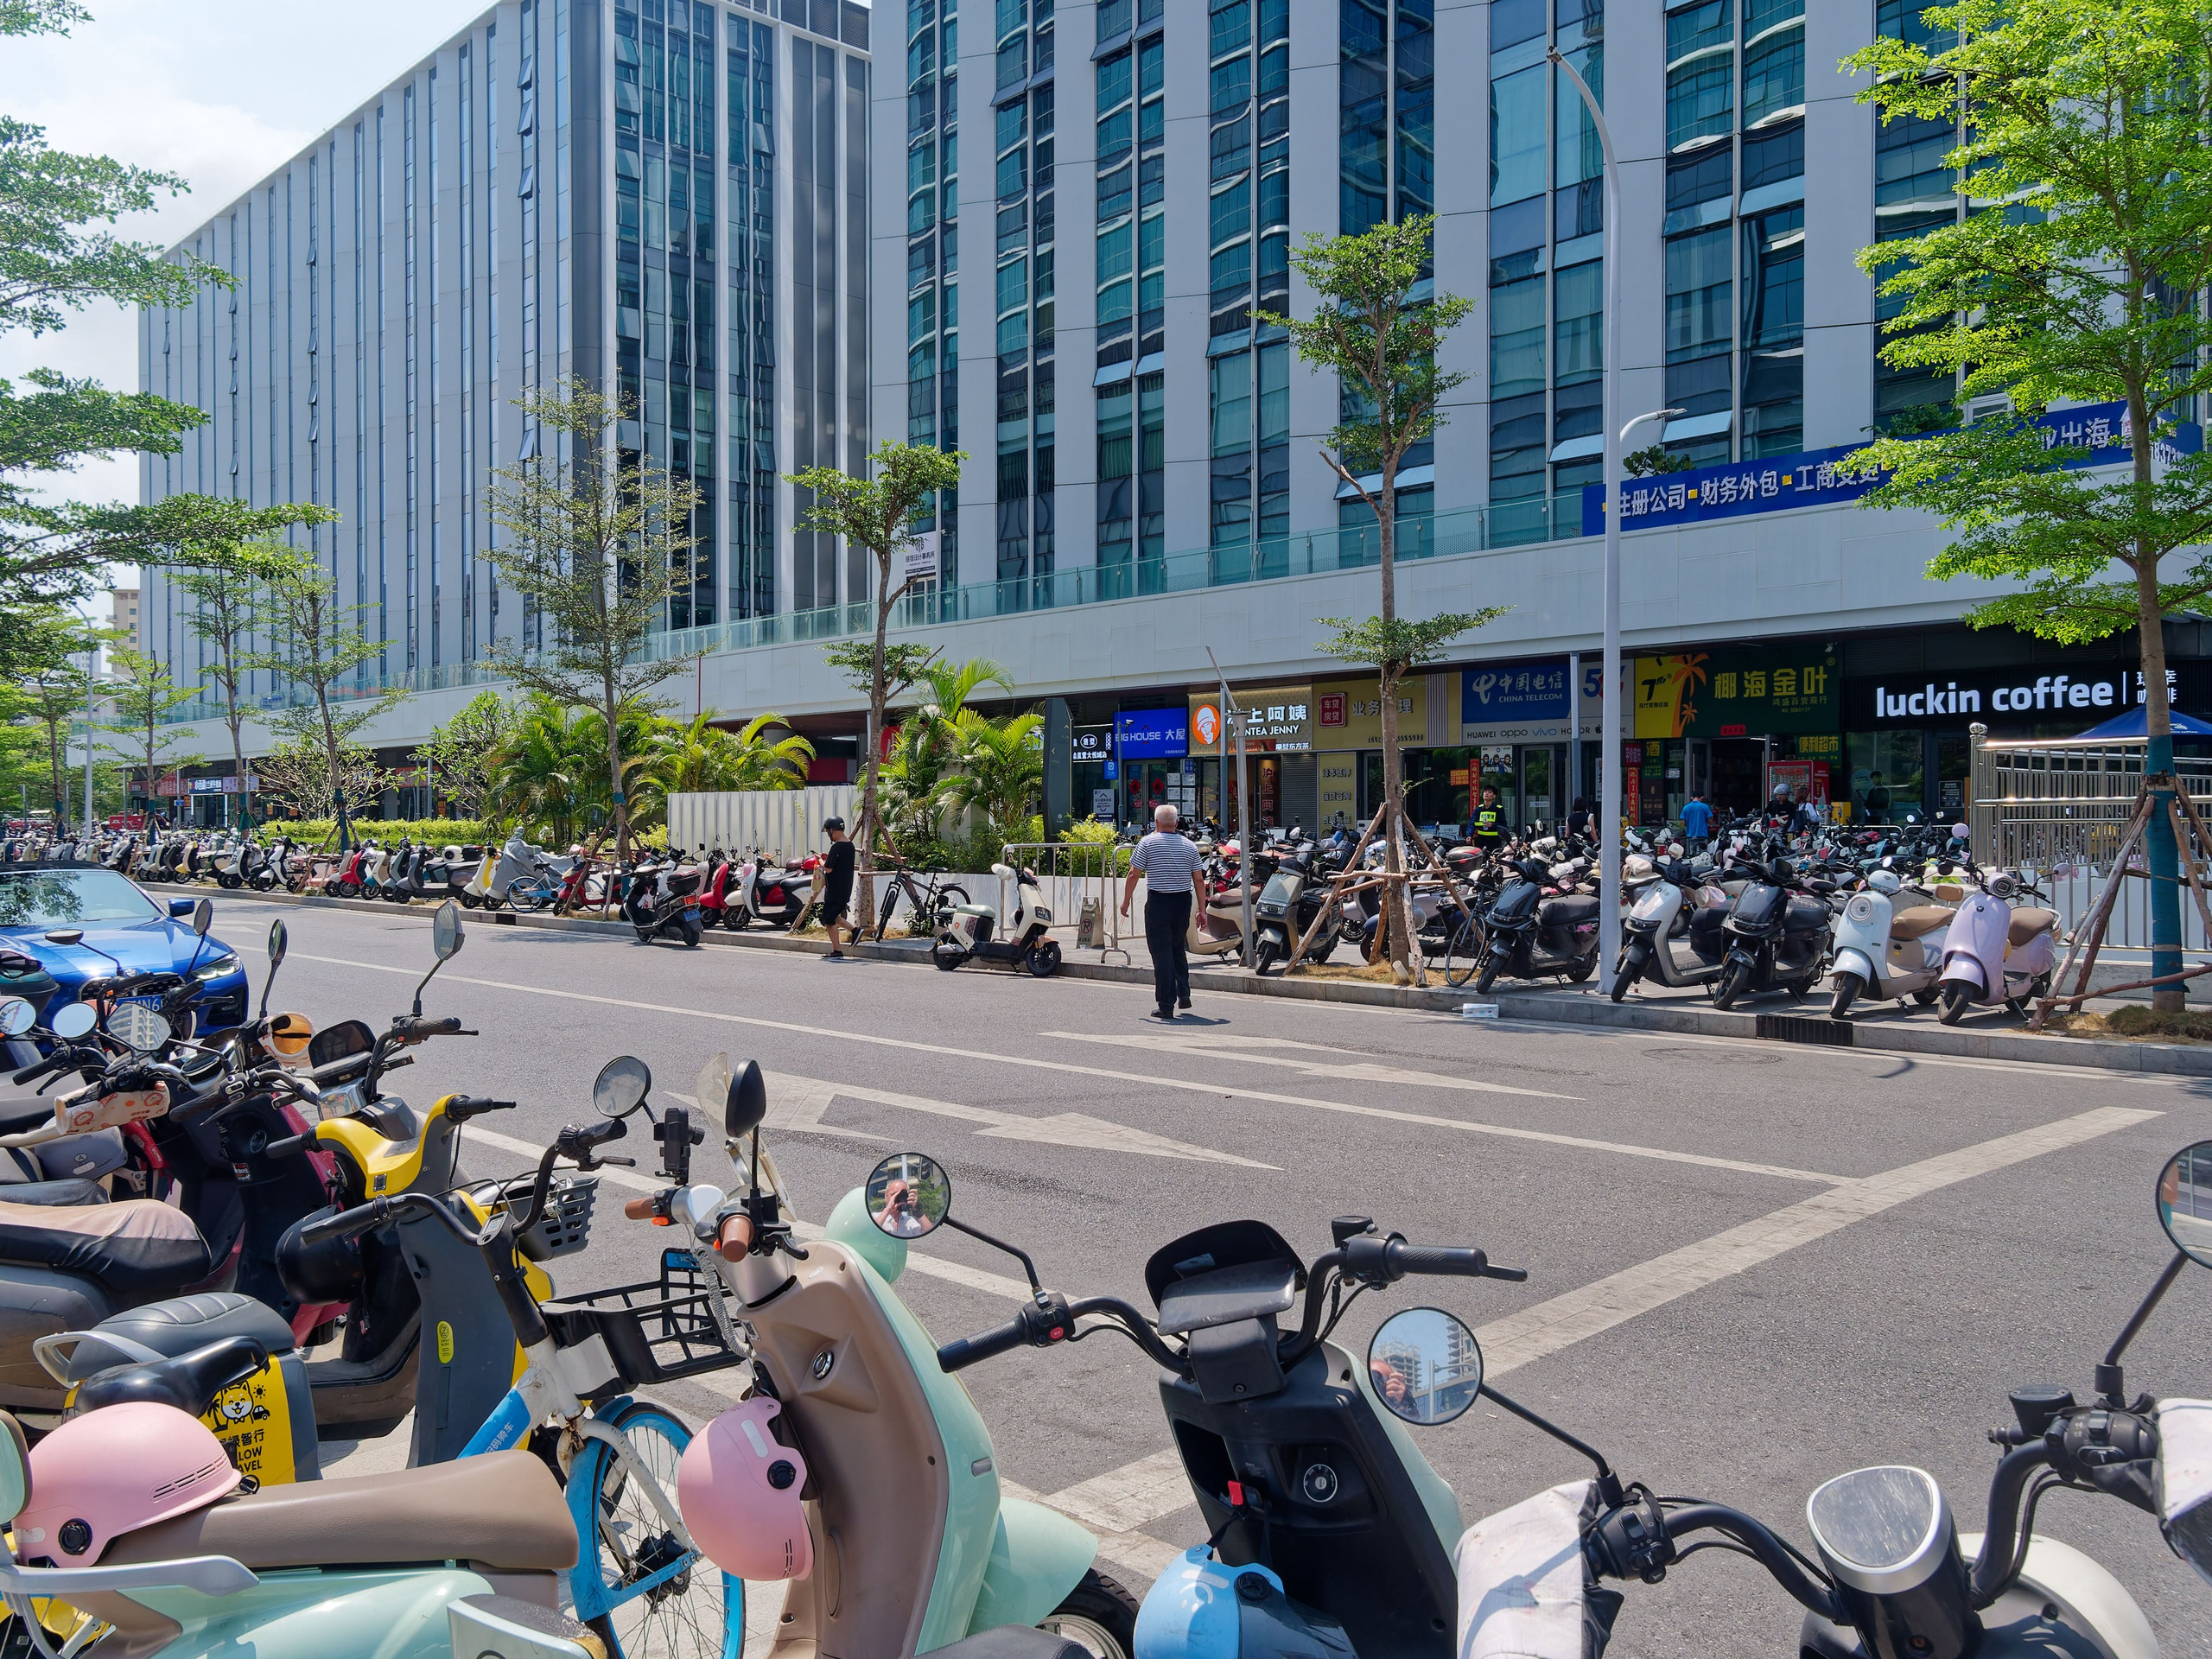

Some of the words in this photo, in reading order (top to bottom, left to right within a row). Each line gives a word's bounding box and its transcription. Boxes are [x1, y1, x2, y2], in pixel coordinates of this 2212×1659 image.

[1700, 470, 1779, 506] 财务外包
[1499, 671, 1563, 694] 中国电信
[1714, 665, 1828, 699] 椰海金叶
[1498, 695, 1523, 703] CHINA
[1525, 693, 1562, 702] TELECOM
[1772, 696, 1827, 707] 鸿盛百货商行
[1877, 682, 1980, 717] luckin
[1992, 675, 2113, 711] coffee
[1324, 699, 1339, 709] 车贷
[1352, 698, 1413, 716] 业务理
[1324, 711, 1339, 721] 房贷
[1130, 731, 1161, 741] HOUSE
[1165, 728, 1185, 741] 大屋
[1232, 727, 1268, 737] NTEA
[1269, 725, 1299, 735] JENNY
[1531, 727, 1557, 736] vivo
[1560, 727, 1590, 735] HOOR
[1645, 741, 1660, 757] 酒
[1799, 736, 1839, 753] 便利超市
[238, 1446, 263, 1461] LOW
[238, 1459, 262, 1473] AVEL
